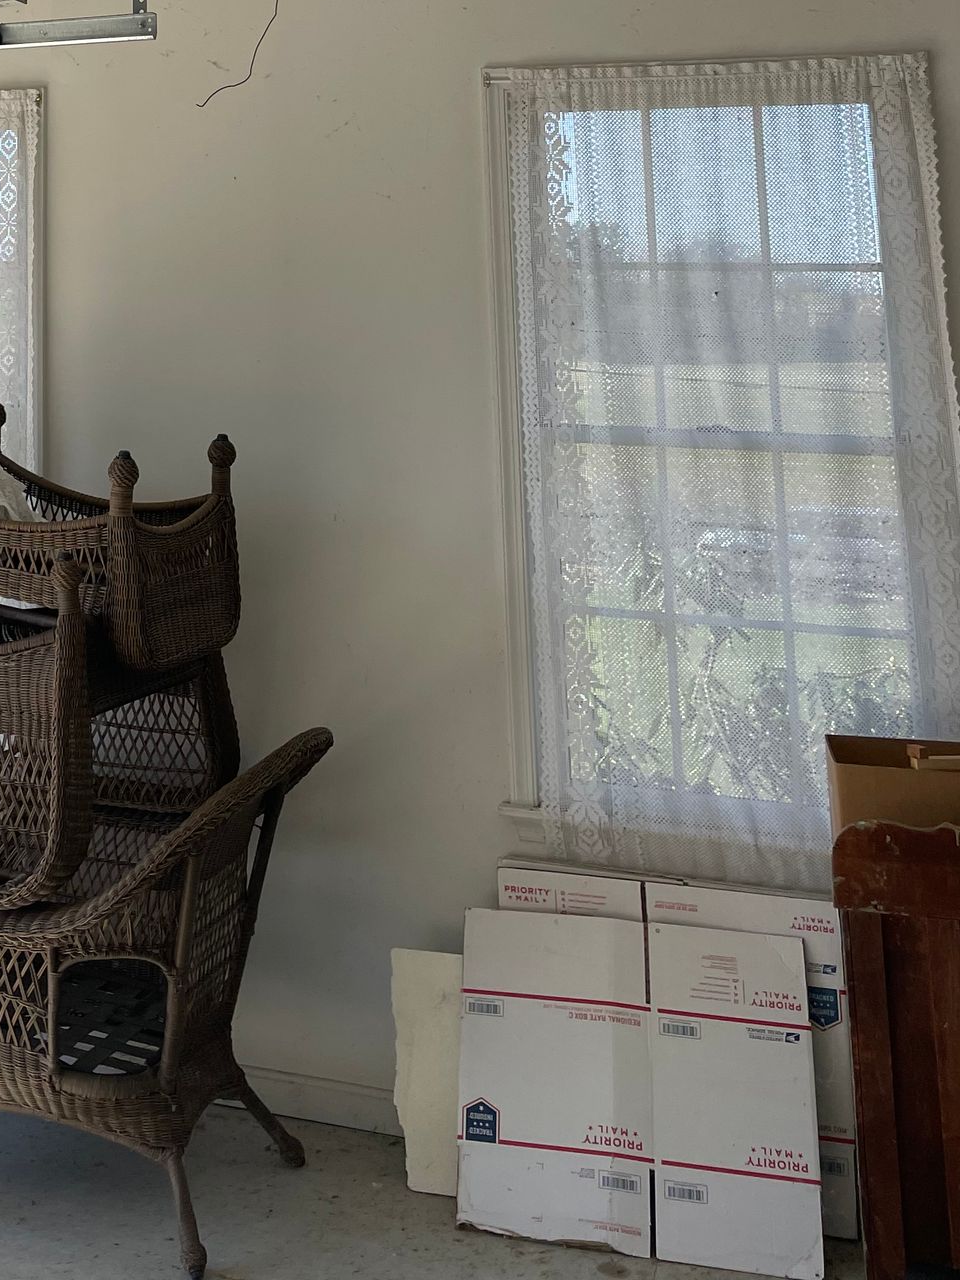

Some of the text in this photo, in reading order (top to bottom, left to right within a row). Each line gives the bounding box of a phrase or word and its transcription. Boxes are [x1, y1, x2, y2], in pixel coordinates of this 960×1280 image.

[504, 885, 550, 897] PRIORITY
[515, 895, 540, 904] MAIL
[800, 916, 822, 924] MAIL
[790, 922, 835, 934] PRIORITY
[762, 990, 789, 1000] MAIL
[751, 998, 802, 1012] PRIORITY
[568, 1011, 574, 1019] C
[575, 1012, 588, 1021] BOX
[589, 1013, 607, 1022] RATE
[469, 1126, 494, 1137] TRACKED
[598, 1124, 629, 1137] MAIL
[583, 1134, 643, 1152] PRIORITY
[761, 1146, 793, 1159] MAIL
[747, 1156, 809, 1174] PRIORITY
